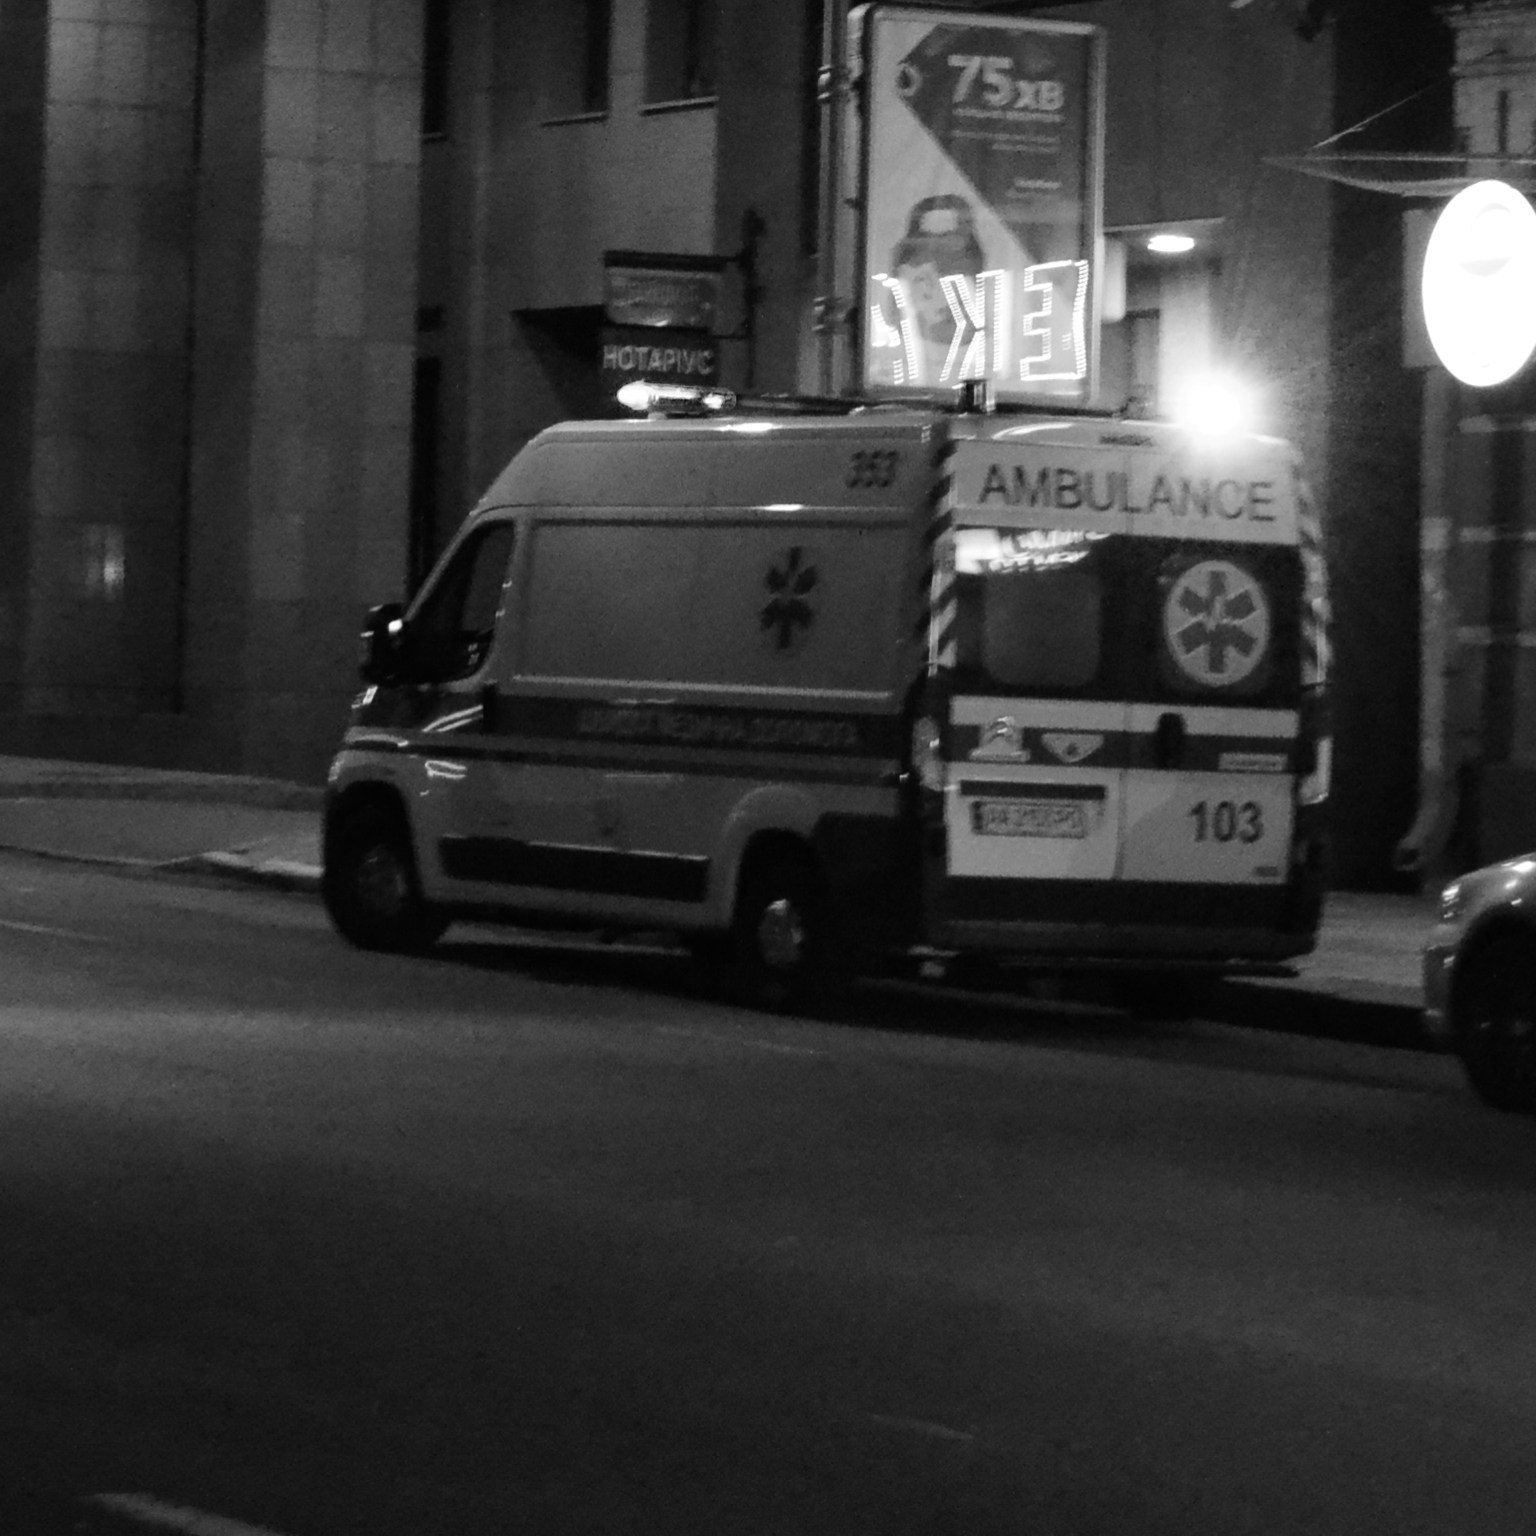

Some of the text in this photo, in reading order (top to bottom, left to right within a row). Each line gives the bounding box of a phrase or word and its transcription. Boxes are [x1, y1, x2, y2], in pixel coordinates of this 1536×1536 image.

[602, 344, 714, 375] НОТАРІУС
[977, 463, 1277, 522] AMBULANCE
[1187, 799, 1265, 844] 103
